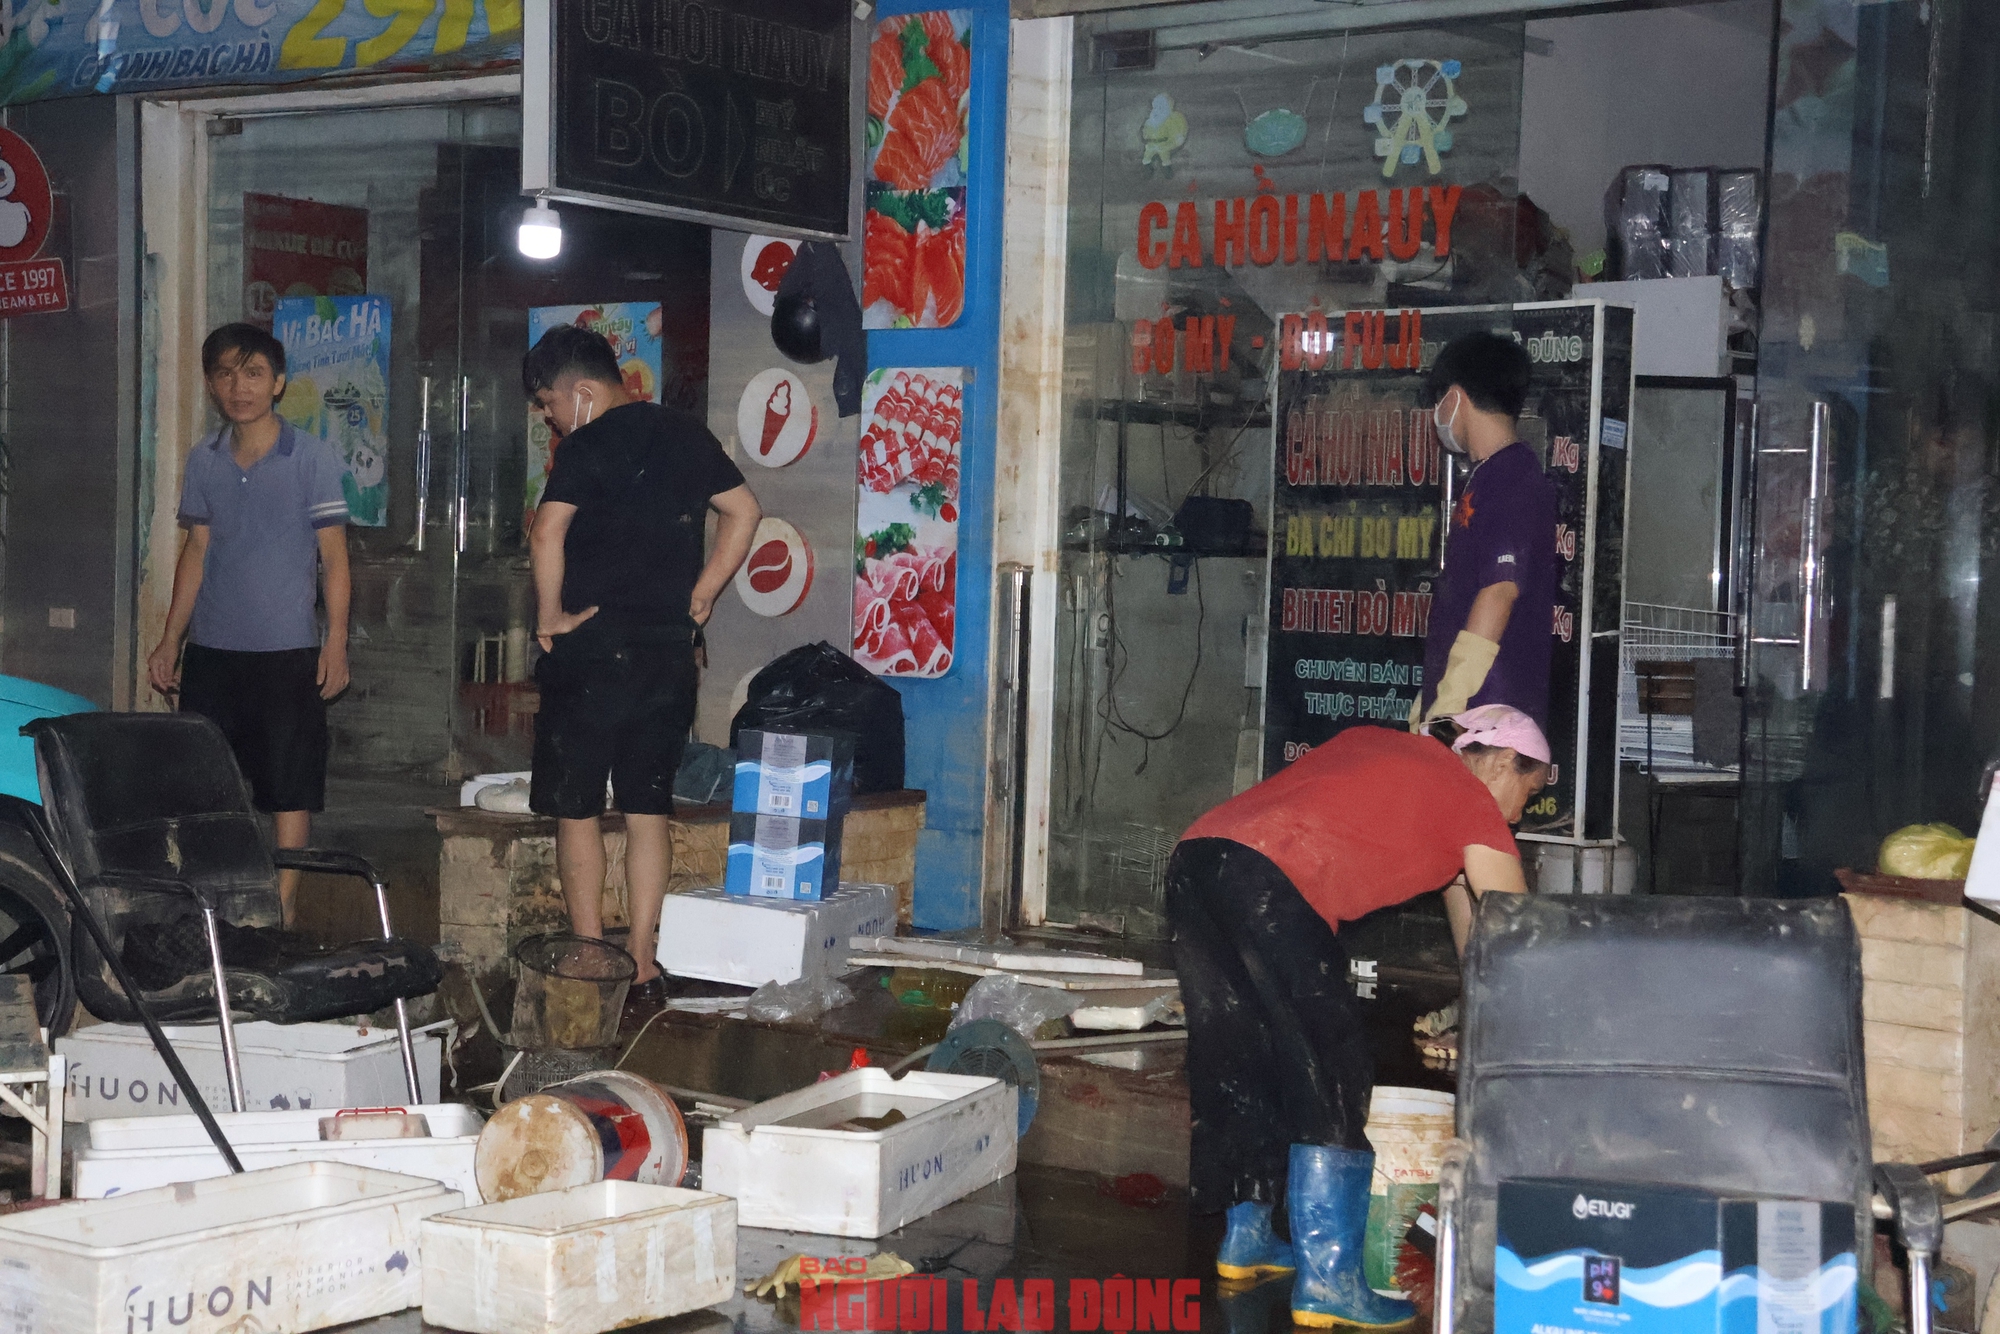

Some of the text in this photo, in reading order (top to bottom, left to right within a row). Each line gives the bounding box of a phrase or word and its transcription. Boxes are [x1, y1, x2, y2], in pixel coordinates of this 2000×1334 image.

[1137, 178, 1203, 270] CÁ
[1307, 184, 1464, 264] NAUY
[21, 267, 55, 291] 1997
[349, 299, 381, 339] HÀ
[1281, 578, 1434, 638] BITTET BÒ MỸ
[1294, 657, 1367, 683] CHUYÊN
[1369, 659, 1409, 686] BÁN
[1304, 687, 1413, 722] THỰC PHẨM
[68, 1066, 179, 1107] HUON
[1589, 1260, 1614, 1278] pH
[125, 1275, 273, 1334] HUON
